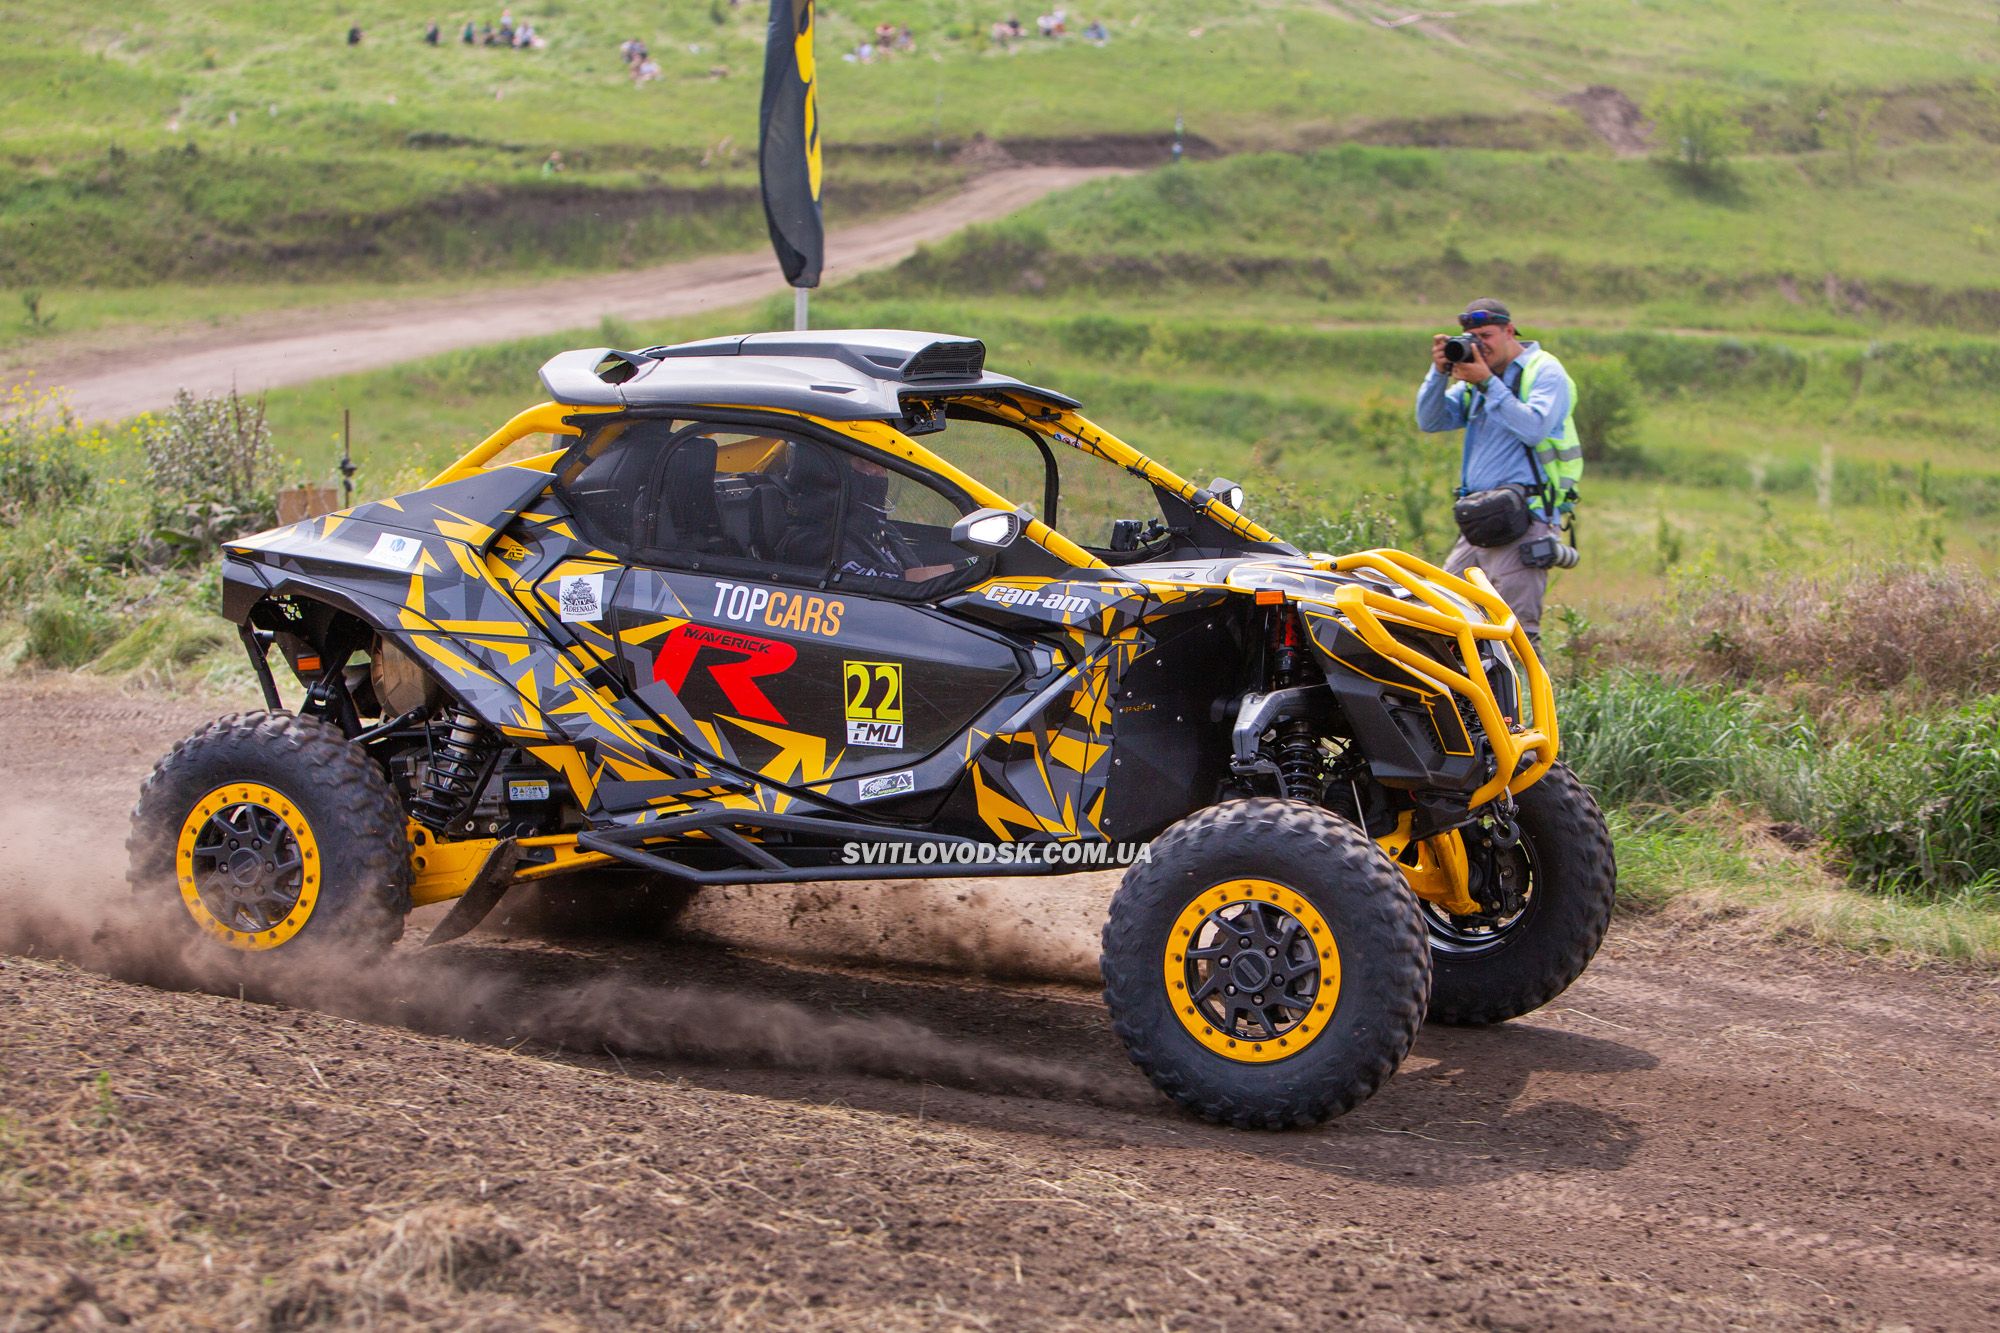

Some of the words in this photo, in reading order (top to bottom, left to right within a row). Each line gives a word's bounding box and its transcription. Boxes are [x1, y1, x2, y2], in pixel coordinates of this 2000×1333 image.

[713, 582, 845, 636] TOPCARS
[985, 586, 1091, 613] can-am
[683, 627, 773, 654] MAVERICK
[847, 664, 901, 720] 22
[853, 722, 902, 743] FMU
